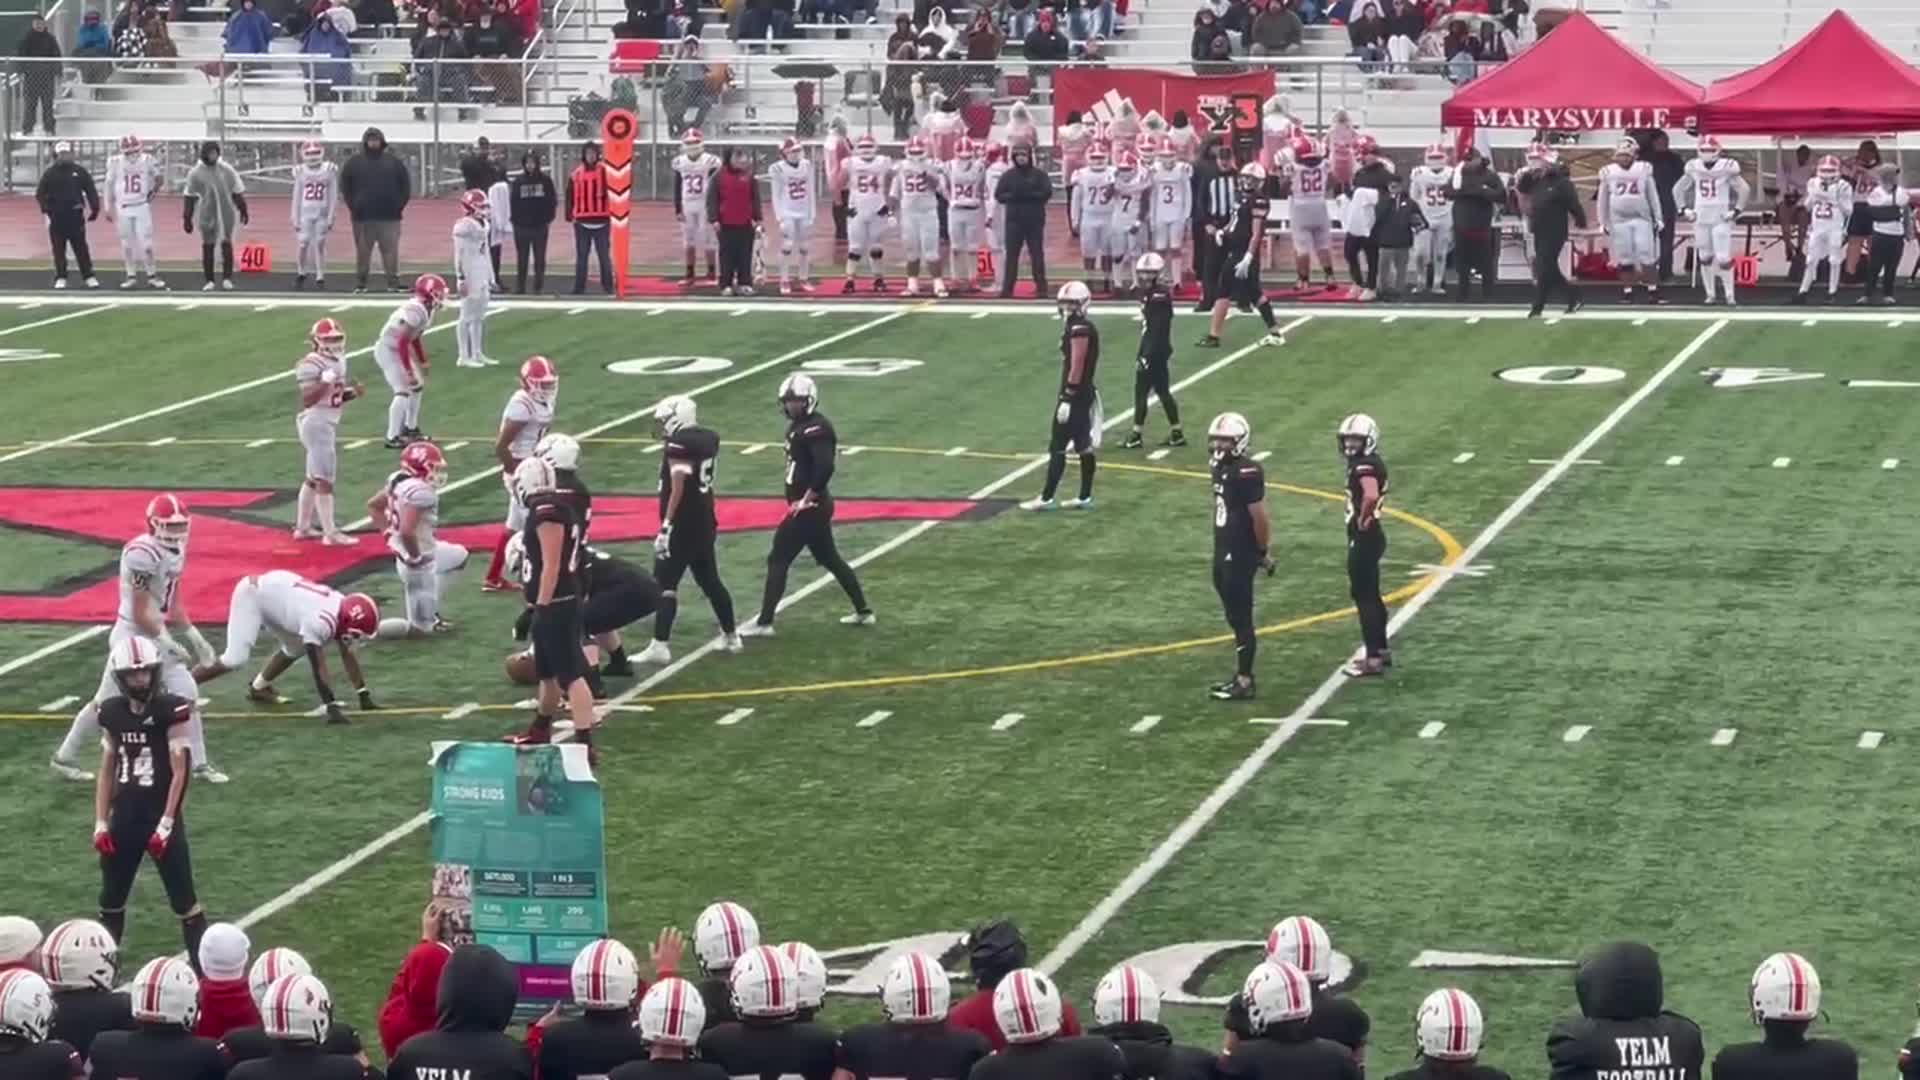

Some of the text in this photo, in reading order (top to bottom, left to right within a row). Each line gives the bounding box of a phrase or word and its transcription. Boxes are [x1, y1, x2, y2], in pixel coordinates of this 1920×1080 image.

[1474, 108, 1671, 128] MARYSVILLE
[123, 175, 141, 192] 16
[1301, 169, 1322, 192] 62
[1701, 180, 1717, 197] 51
[305, 184, 325, 200] 28
[1163, 186, 1174, 204] 3
[241, 247, 265, 267] 40
[119, 746, 154, 786] 14
[444, 786, 504, 800] STRONG KIDS
[1615, 1036, 1671, 1066] YELM
